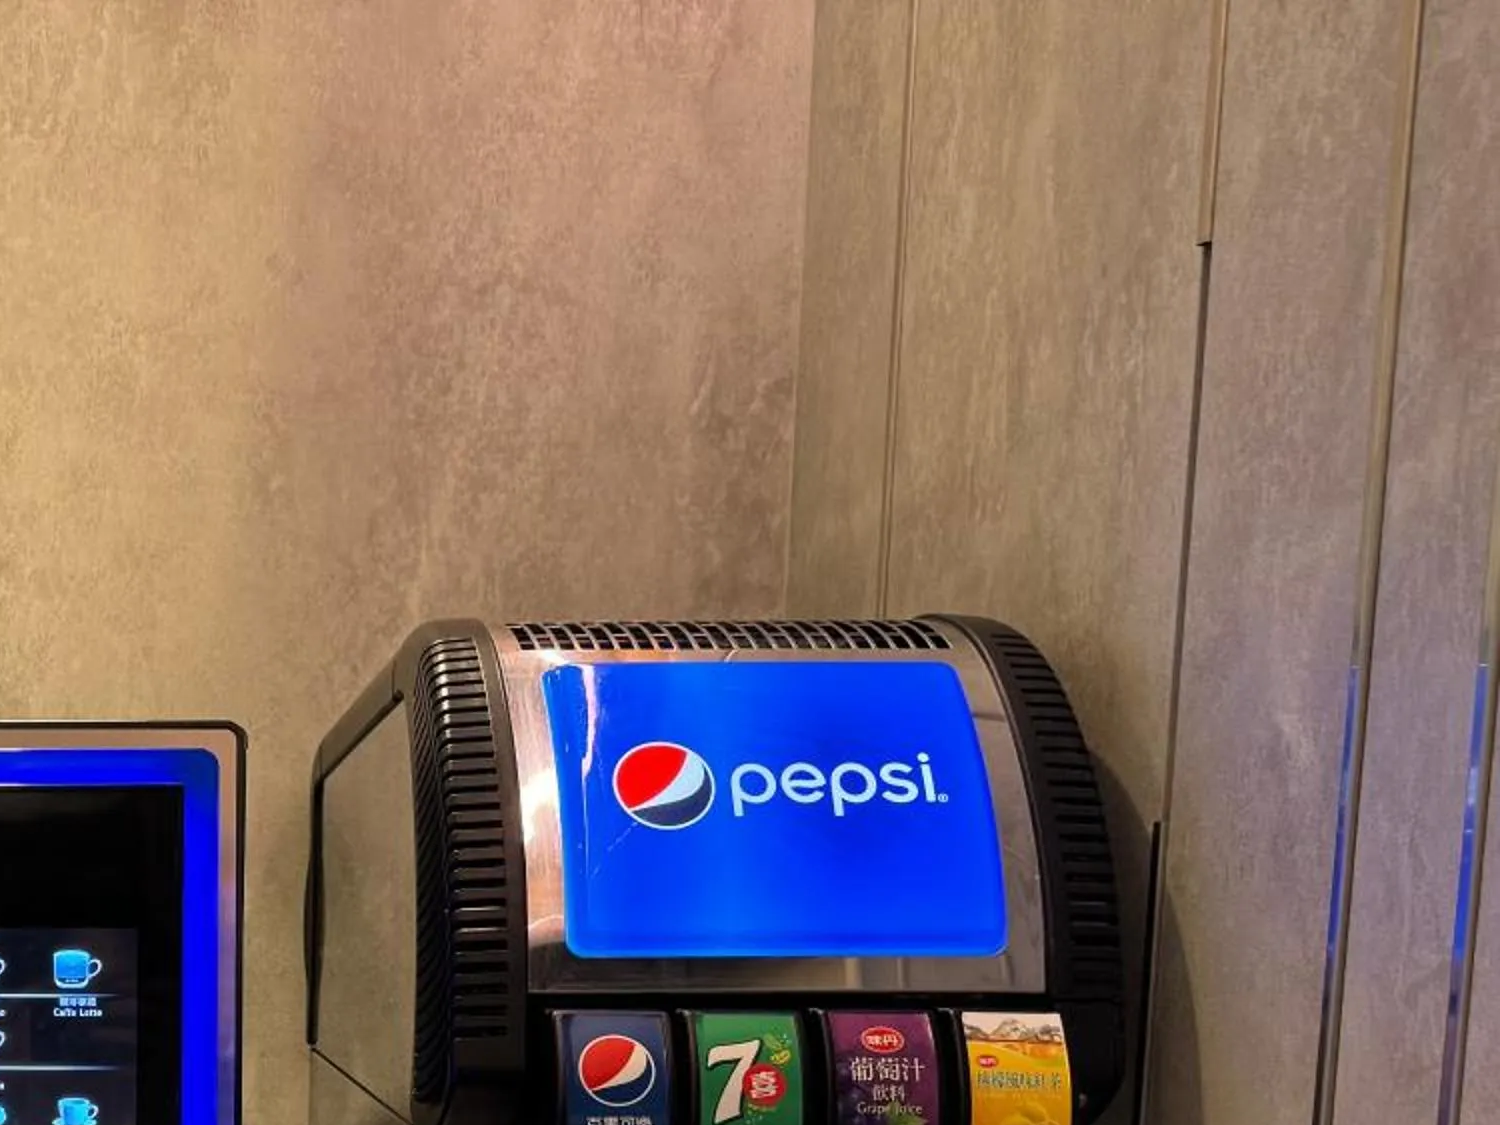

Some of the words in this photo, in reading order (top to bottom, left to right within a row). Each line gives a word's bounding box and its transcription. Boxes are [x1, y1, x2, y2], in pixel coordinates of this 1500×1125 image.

[731, 752, 937, 817] pepsi
[851, 1056, 925, 1082] 葡萄汁
[873, 1084, 905, 1102] 飲料
